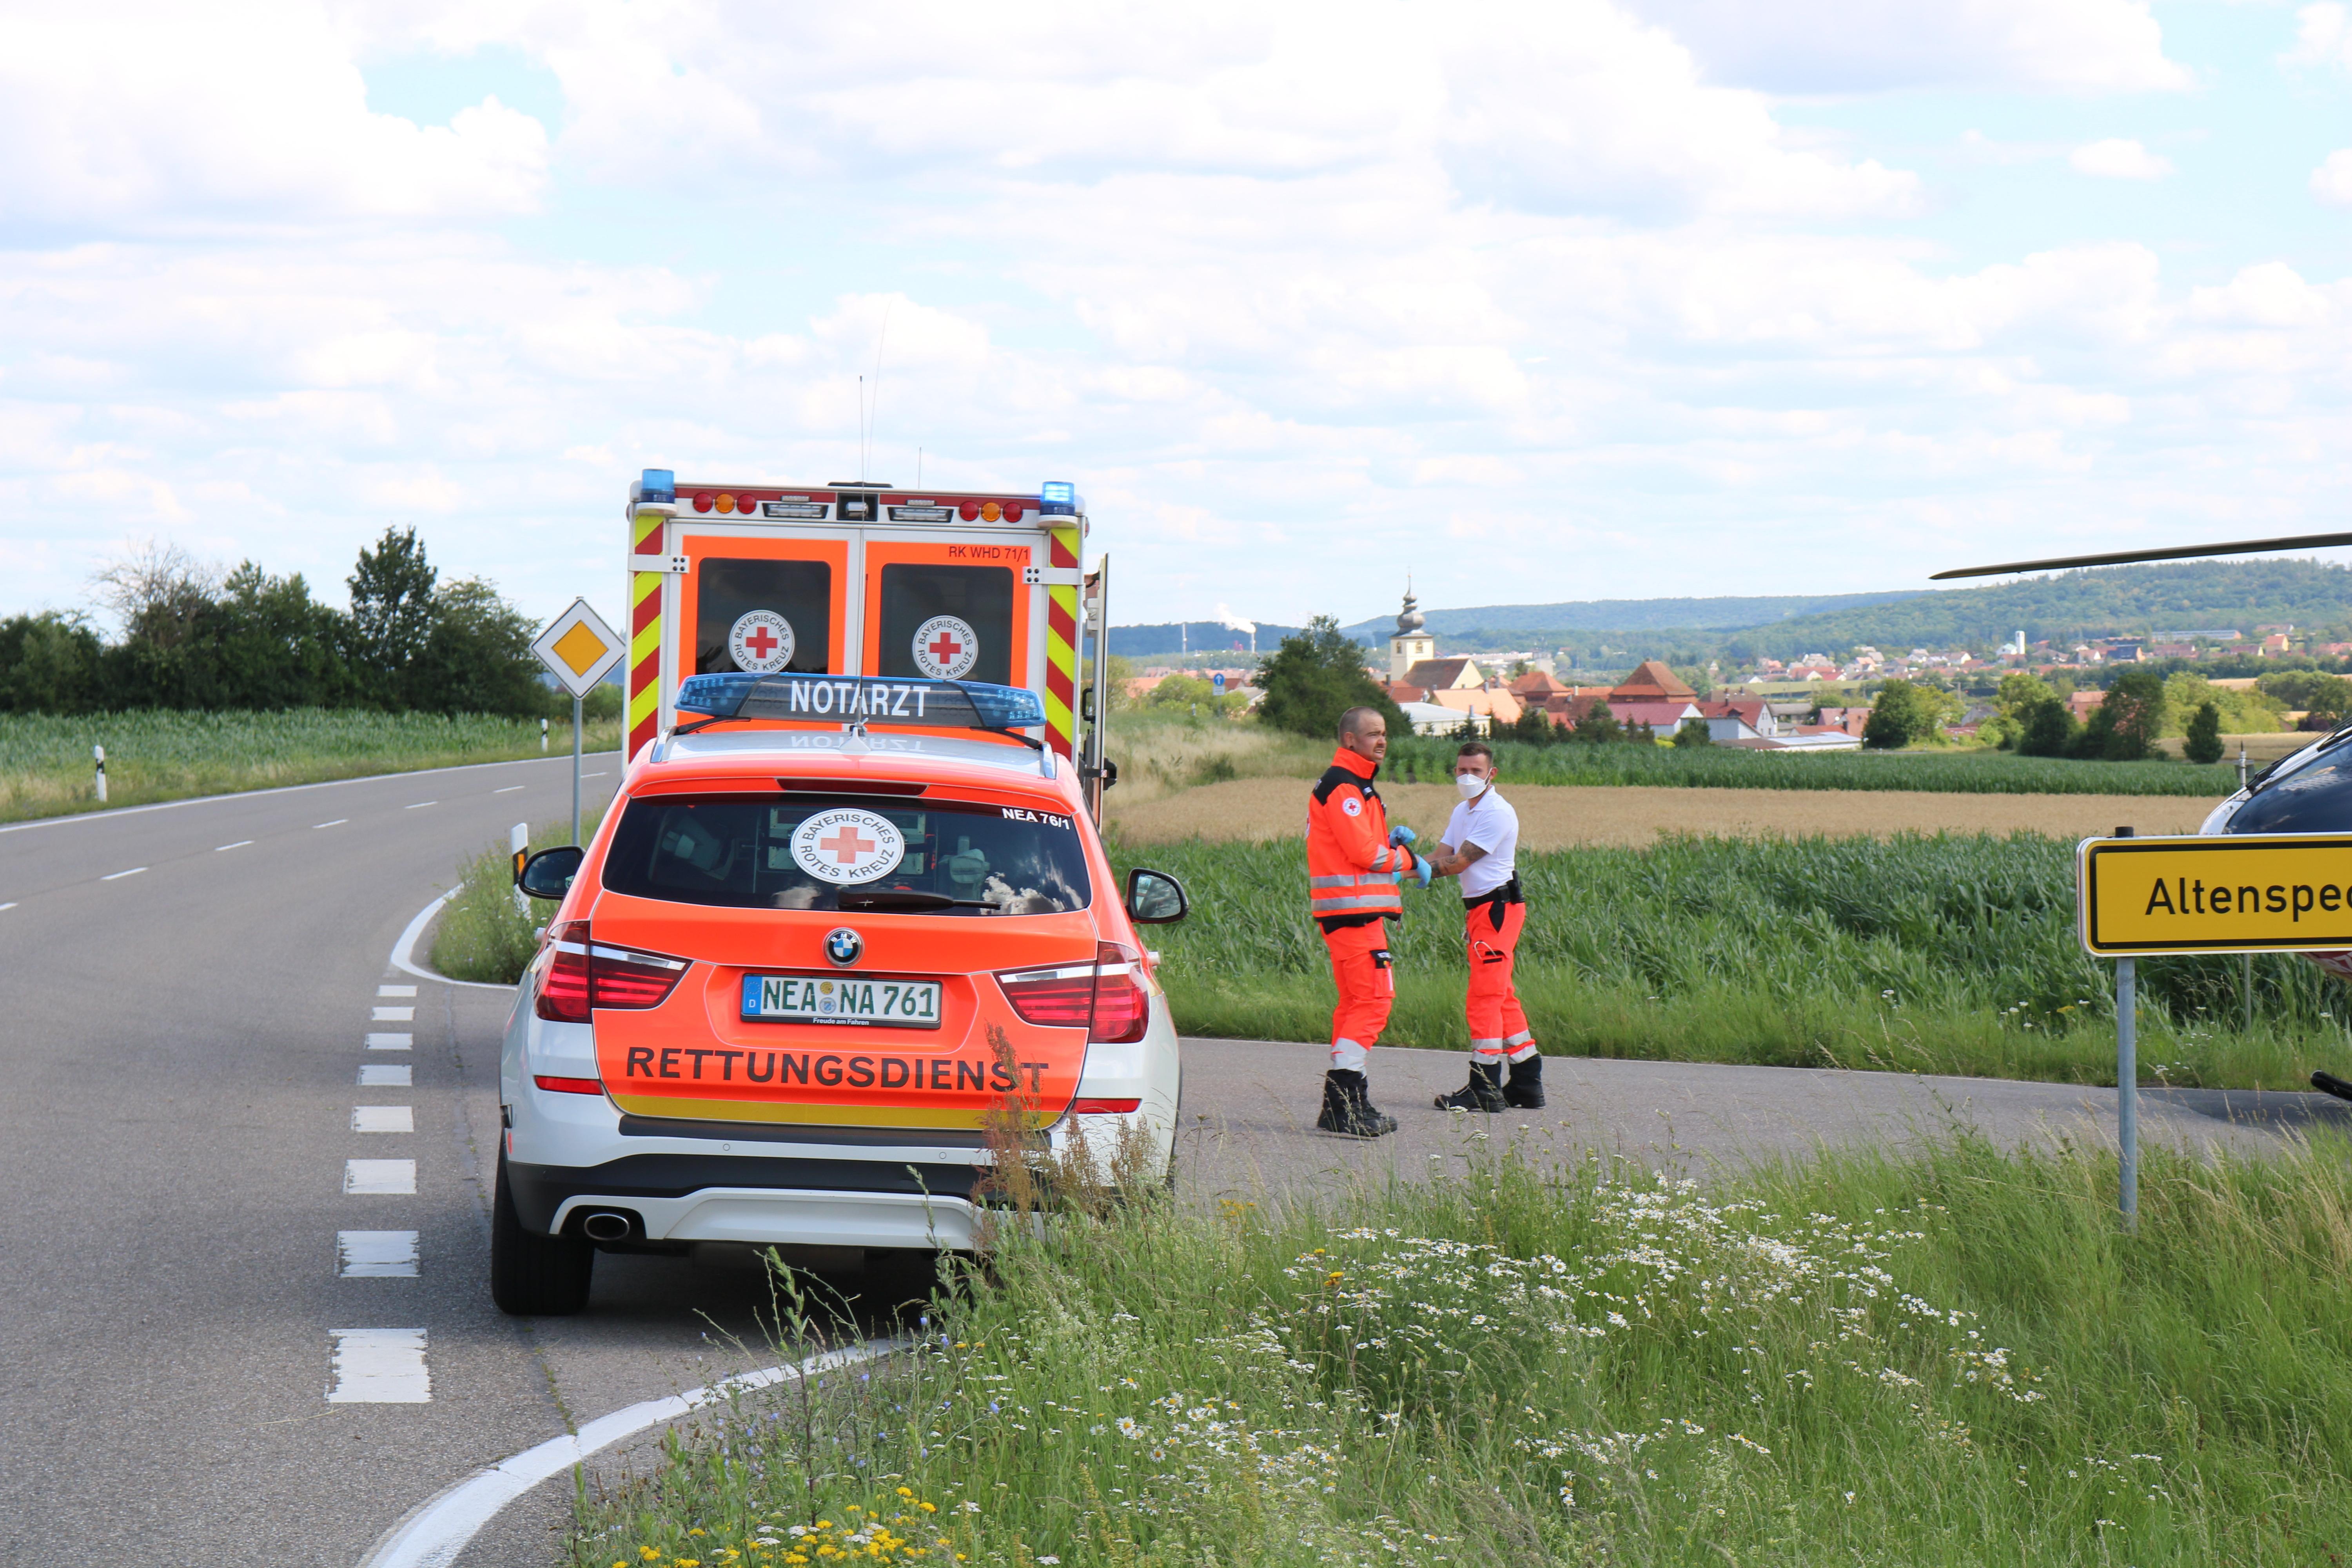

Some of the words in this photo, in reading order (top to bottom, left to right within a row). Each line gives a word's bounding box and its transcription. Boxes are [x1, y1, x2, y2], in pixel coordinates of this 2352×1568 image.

[949, 546, 966, 558] RK
[970, 546, 1000, 559] WHD
[1005, 548, 1028, 562] 71/1
[735, 615, 789, 640] BAYERISCHES
[918, 620, 973, 645] BAYERISCHES
[734, 644, 758, 670] ROTES
[762, 646, 789, 671] KREUZ
[918, 650, 942, 675] ROTES
[946, 651, 973, 676] KREUZ
[790, 681, 931, 717] NOTARZT
[802, 813, 895, 844] BAYERISCHES
[1002, 808, 1038, 822] NEA
[1039, 813, 1070, 830] 76/1
[800, 845, 841, 877] ROTES
[848, 849, 895, 878] KREUZ
[2145, 877, 2352, 922] Altenspe
[830, 933, 857, 944] BMW
[748, 999, 756, 1008] D
[763, 980, 817, 1011] NEA
[840, 984, 875, 1014] NA
[884, 985, 934, 1017] 761
[627, 1047, 1049, 1093] RETTUNGSDIENST
